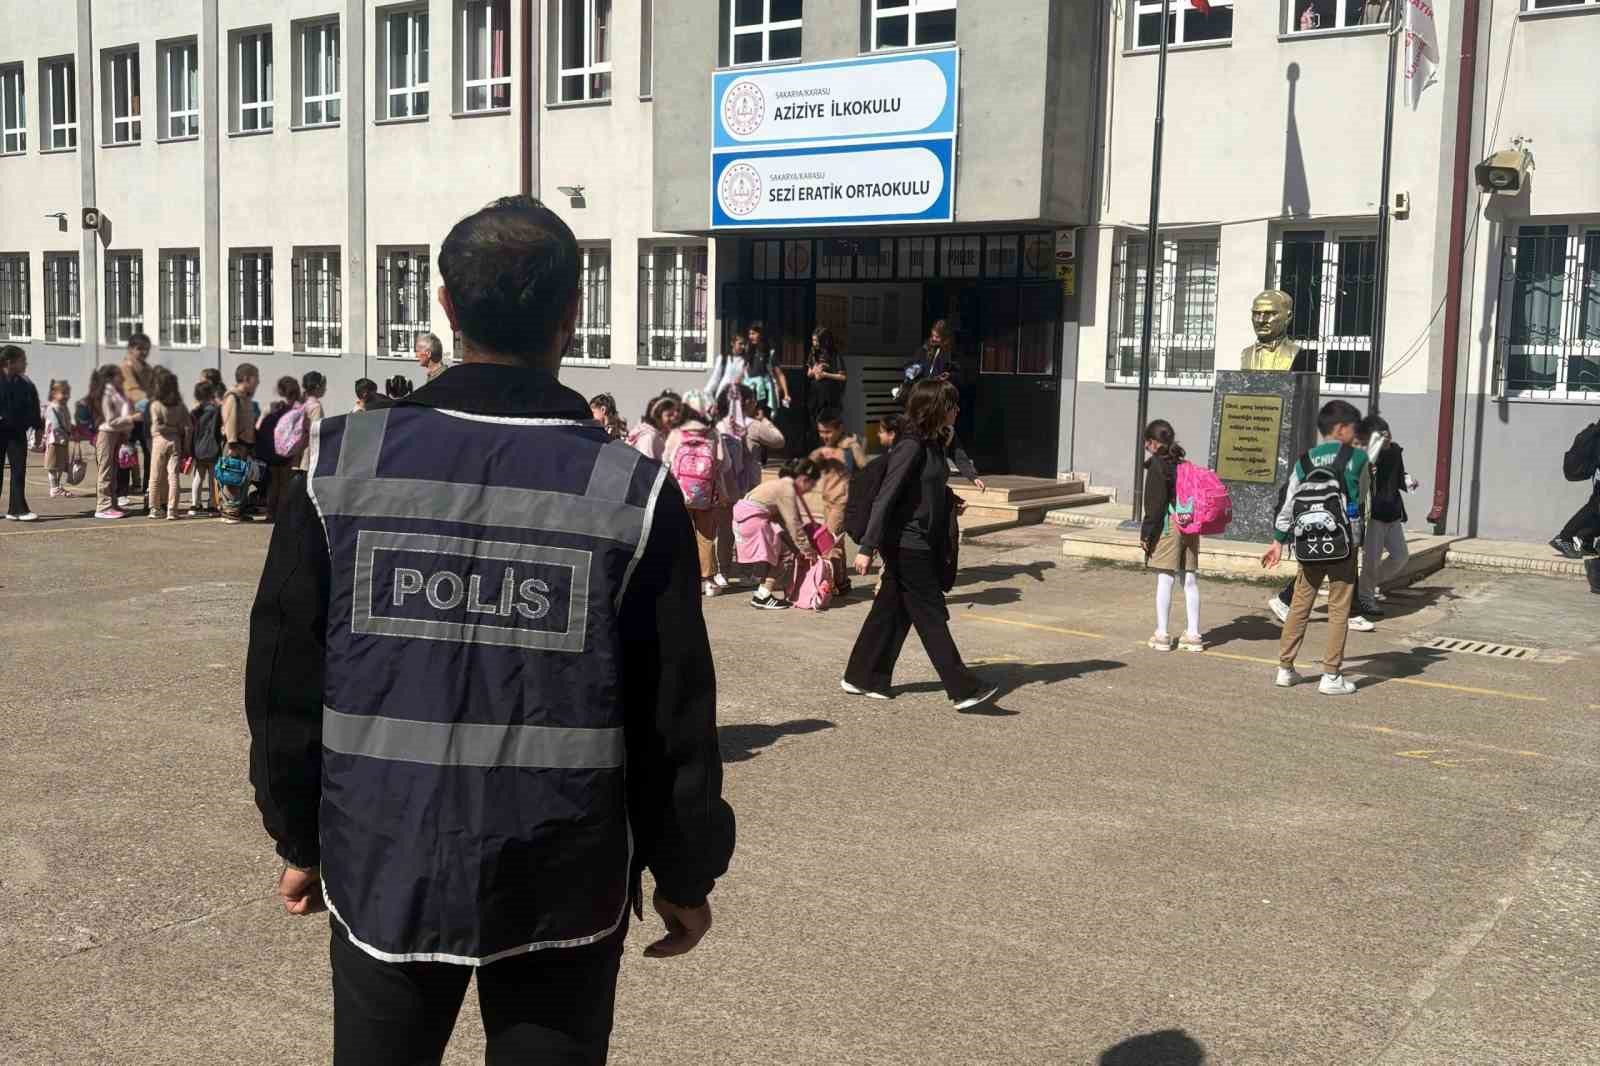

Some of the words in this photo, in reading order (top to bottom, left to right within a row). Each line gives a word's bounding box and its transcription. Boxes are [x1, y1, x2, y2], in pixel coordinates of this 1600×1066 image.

[774, 102, 825, 121] AZİZİYE
[831, 97, 901, 118] İLKOKULU
[769, 185, 795, 202] SEZİ
[798, 182, 843, 201] ERATİK
[845, 180, 930, 200] ORTAOKULU
[392, 566, 551, 620] POLİS
